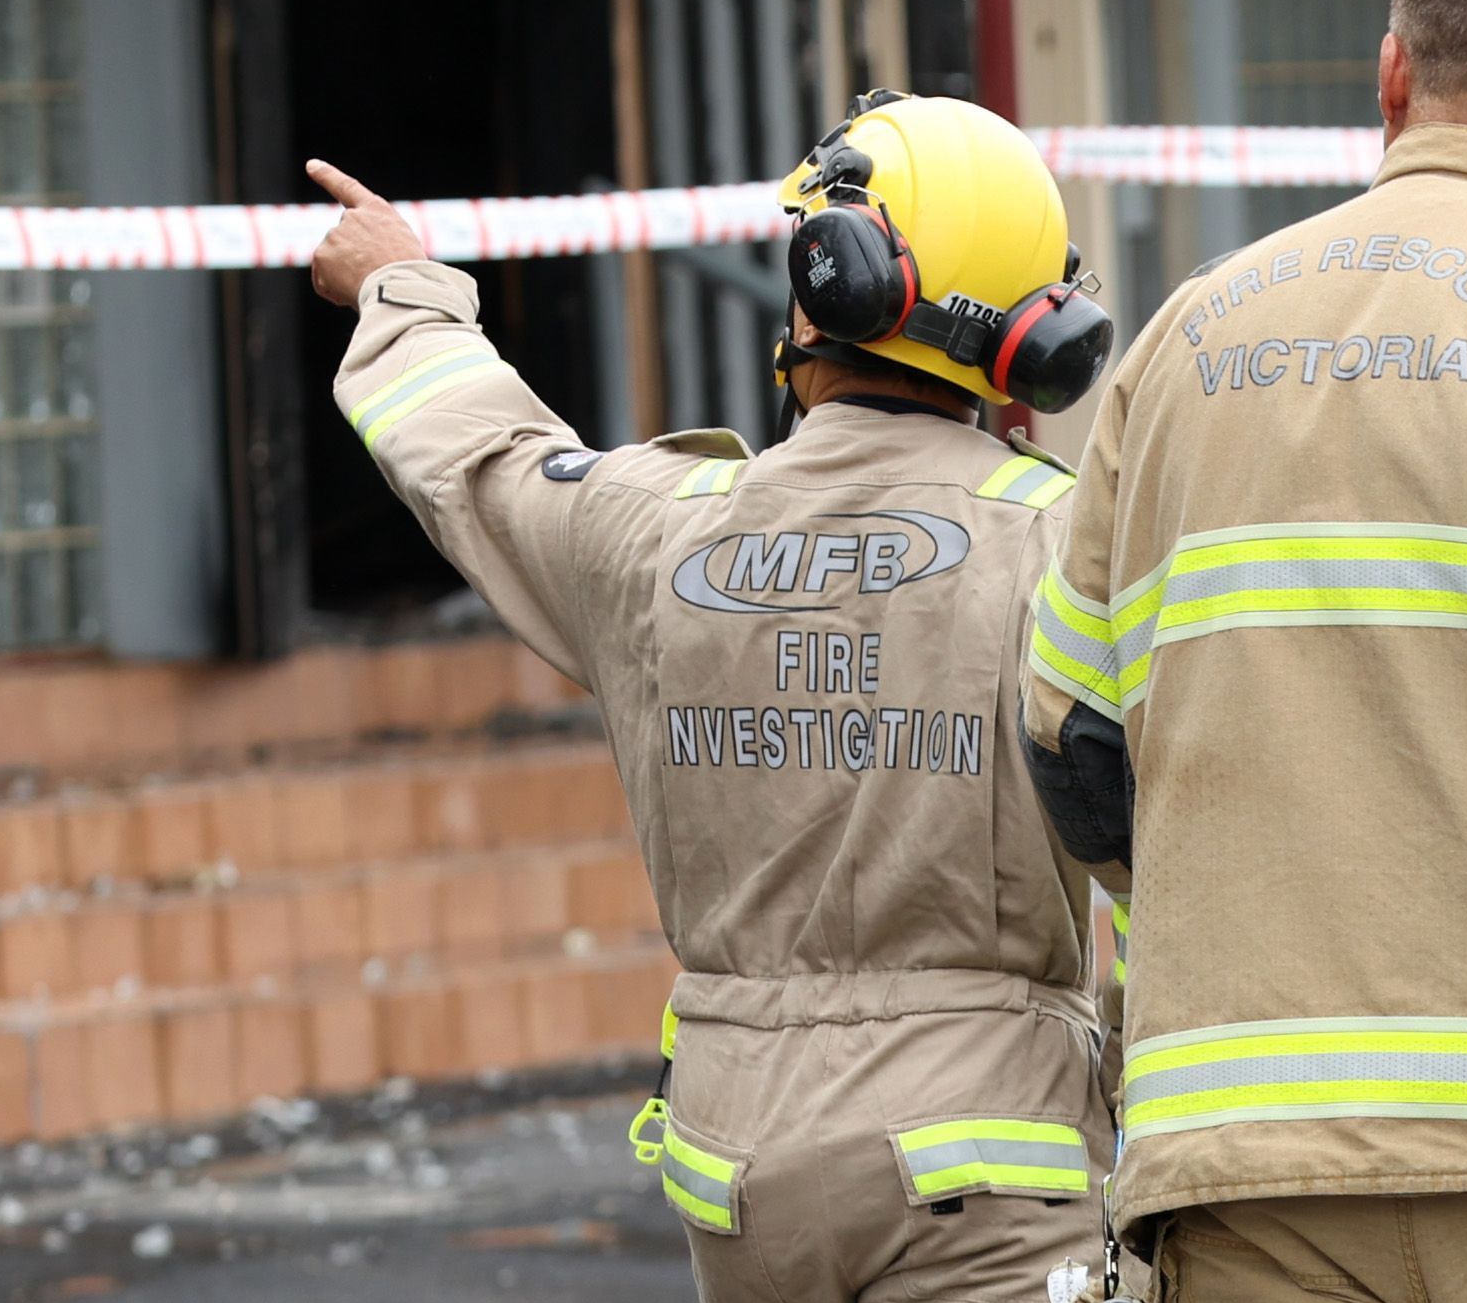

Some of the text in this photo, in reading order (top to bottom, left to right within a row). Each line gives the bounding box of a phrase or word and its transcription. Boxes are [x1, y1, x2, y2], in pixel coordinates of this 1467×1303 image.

[1182, 249, 1303, 346] FIRE
[724, 532, 910, 594] MFB
[776, 631, 881, 693] FIRE
[662, 705, 982, 776] NVESTIGATION
